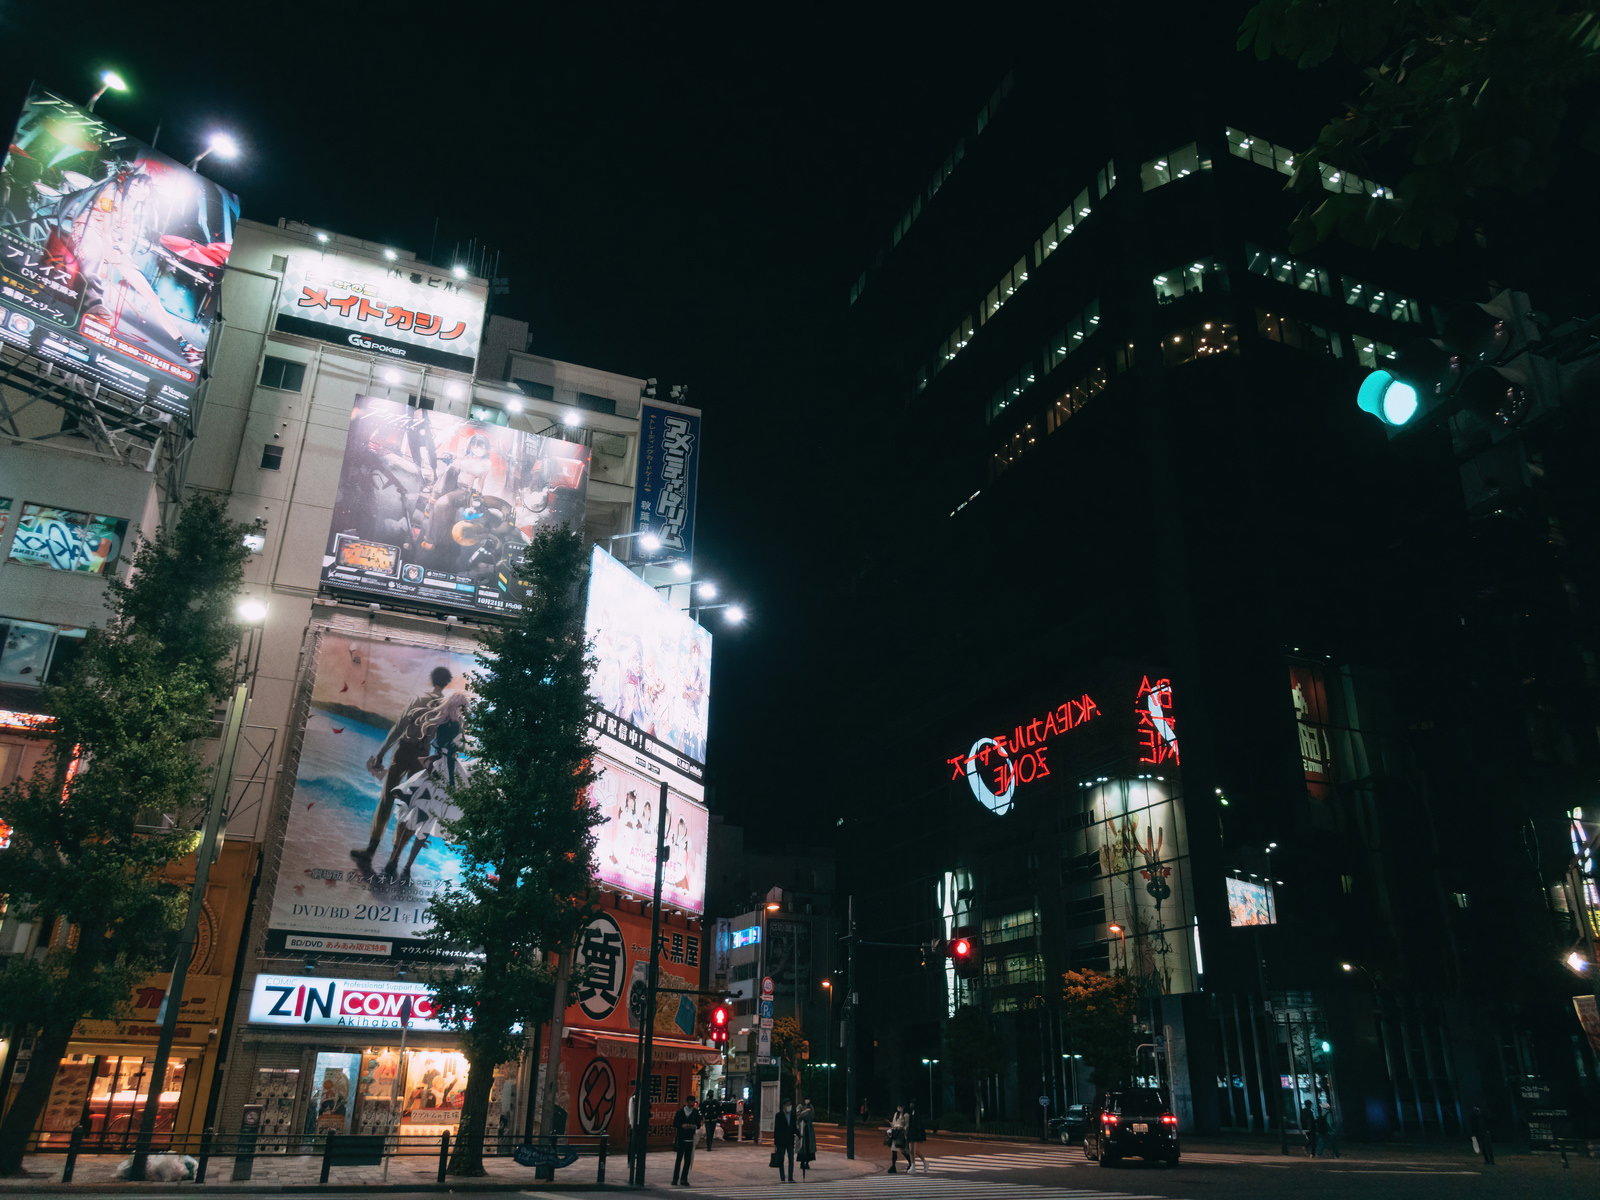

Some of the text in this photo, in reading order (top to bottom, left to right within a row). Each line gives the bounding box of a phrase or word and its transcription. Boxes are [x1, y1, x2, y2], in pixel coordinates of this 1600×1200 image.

[298, 285, 466, 340] メイドカジノ
[292, 903, 433, 925] DVD/BD 2021年10
[291, 938, 323, 948] BD/DVD
[577, 930, 622, 1009] 質
[343, 981, 385, 990] Professional
[386, 983, 412, 992] Support
[264, 980, 336, 1023] ZIN
[343, 992, 433, 1018] COMC
[338, 1016, 414, 1029] Akihabaa
[649, 1074, 680, 1104] 黒屋
